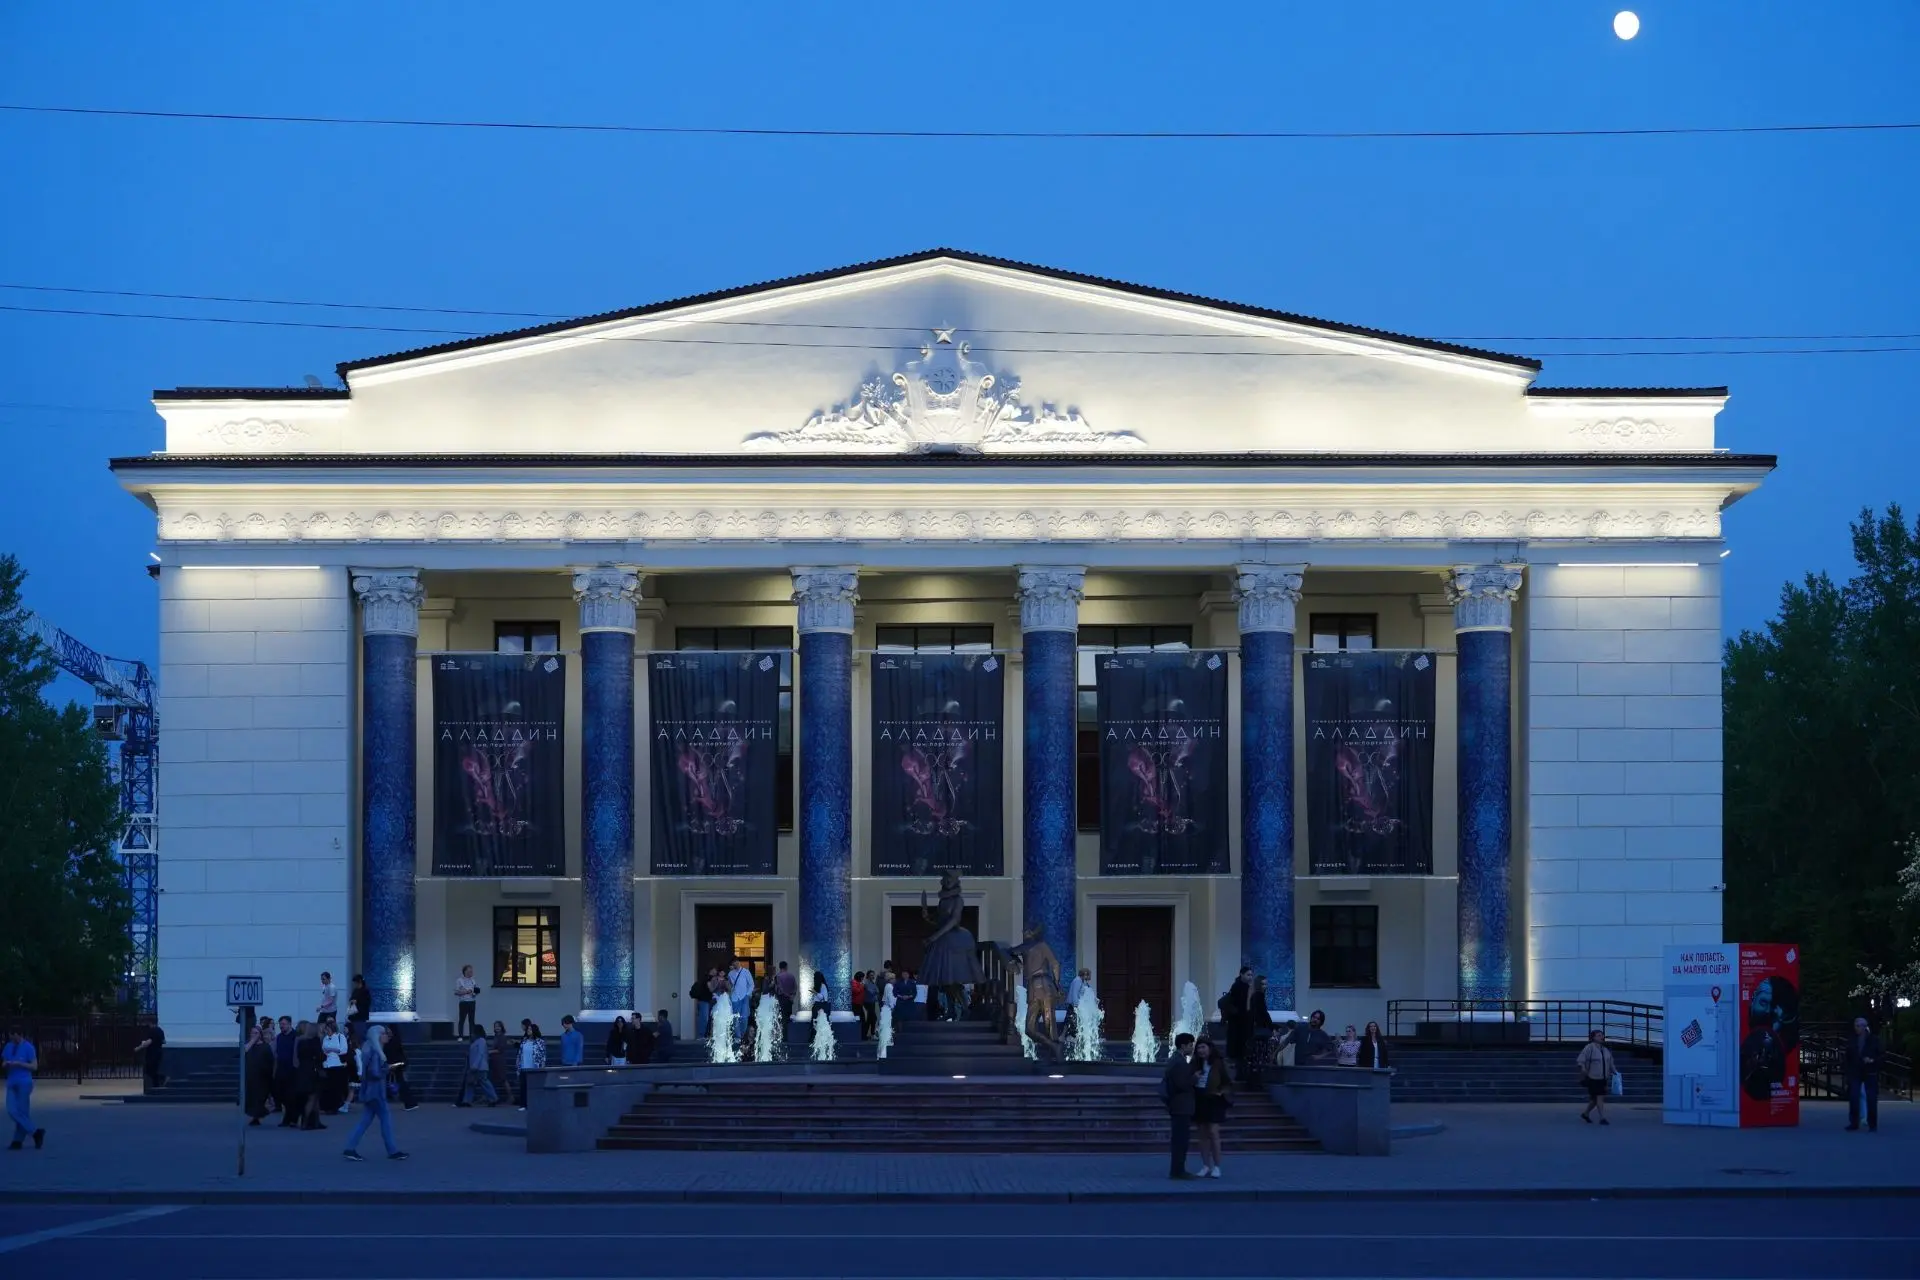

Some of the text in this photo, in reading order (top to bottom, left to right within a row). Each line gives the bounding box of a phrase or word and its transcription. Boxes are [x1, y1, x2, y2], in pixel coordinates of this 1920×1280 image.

[441, 728, 557, 740] АЛАДДИН
[657, 727, 772, 740] АЛАДДИН
[880, 728, 996, 740] АЛАДДИН
[1105, 726, 1221, 740] АЛАДДИН
[1313, 726, 1427, 739] АЛАДДИН
[707, 941, 727, 949] ВХОД
[1680, 952, 1725, 962] КАК ПОПАСТЬ
[1672, 965, 1682, 974] НА
[1683, 964, 1707, 974] МАЛУЮ
[1709, 964, 1731, 975] СЦЕНУ
[233, 980, 259, 1001] СТОП
